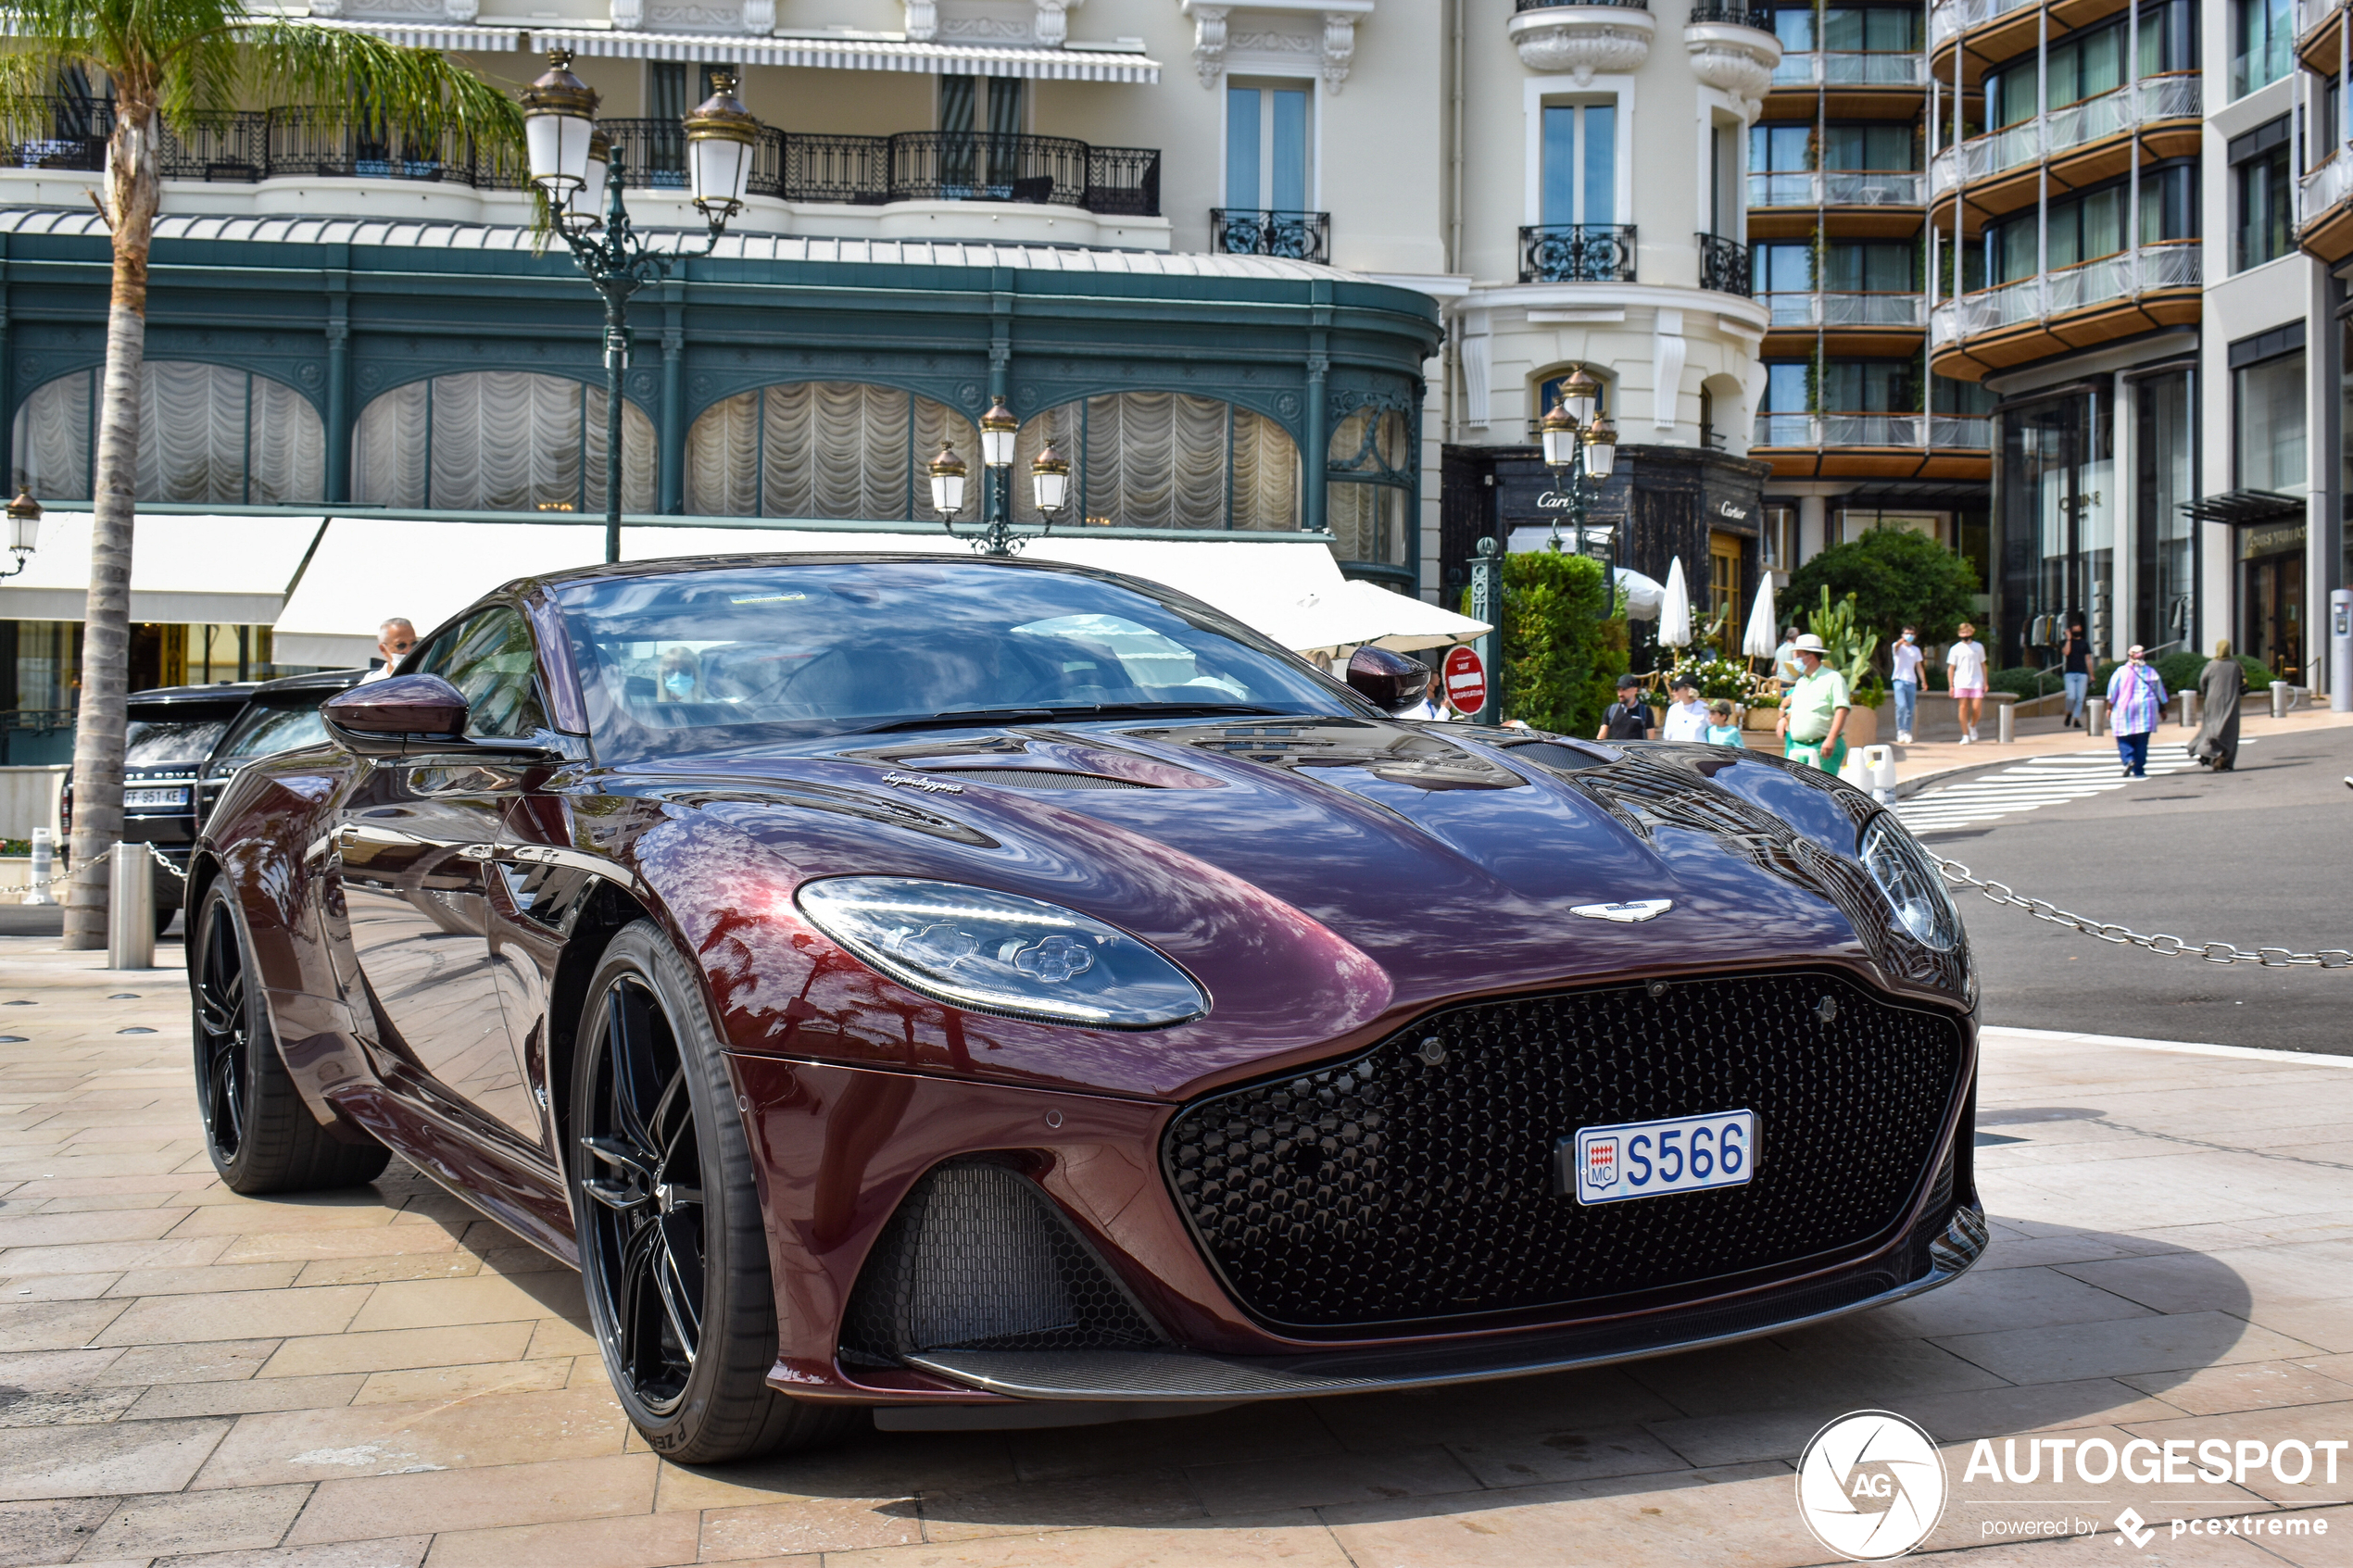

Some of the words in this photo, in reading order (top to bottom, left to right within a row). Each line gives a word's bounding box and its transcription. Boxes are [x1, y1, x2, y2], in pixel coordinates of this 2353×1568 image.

[1720, 500, 1746, 520] Cartier
[1457, 662, 1469, 671] SAUF
[1453, 689, 1484, 700] AUTORISATION
[882, 771, 963, 794] Superleggera
[1627, 1123, 1743, 1185] S566
[1592, 1167, 1612, 1183] MC
[638, 1426, 676, 1449] ZERO
